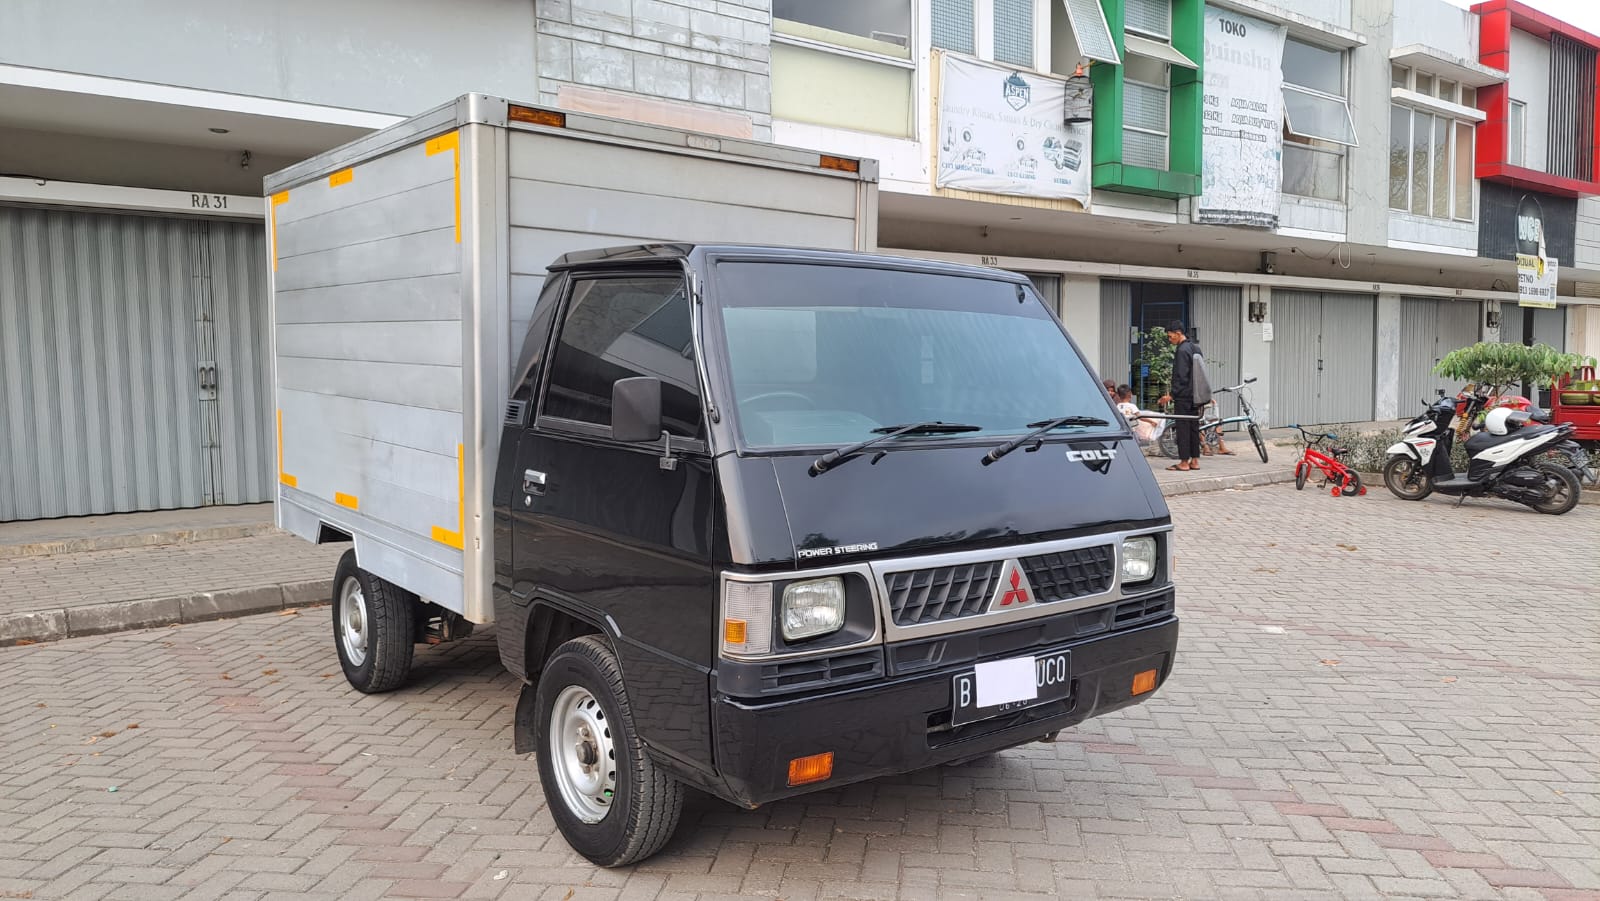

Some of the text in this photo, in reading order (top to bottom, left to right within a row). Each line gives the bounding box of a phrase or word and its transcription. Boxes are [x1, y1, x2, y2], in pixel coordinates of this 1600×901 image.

[1219, 18, 1246, 37] TOKO
[1005, 85, 1029, 99] ASPEN
[191, 194, 227, 209] RA 31
[981, 256, 998, 266] RA 33
[1065, 449, 1118, 463] COLT
[797, 542, 878, 559] POWER STEERING
[960, 655, 1066, 708] B UCQ
